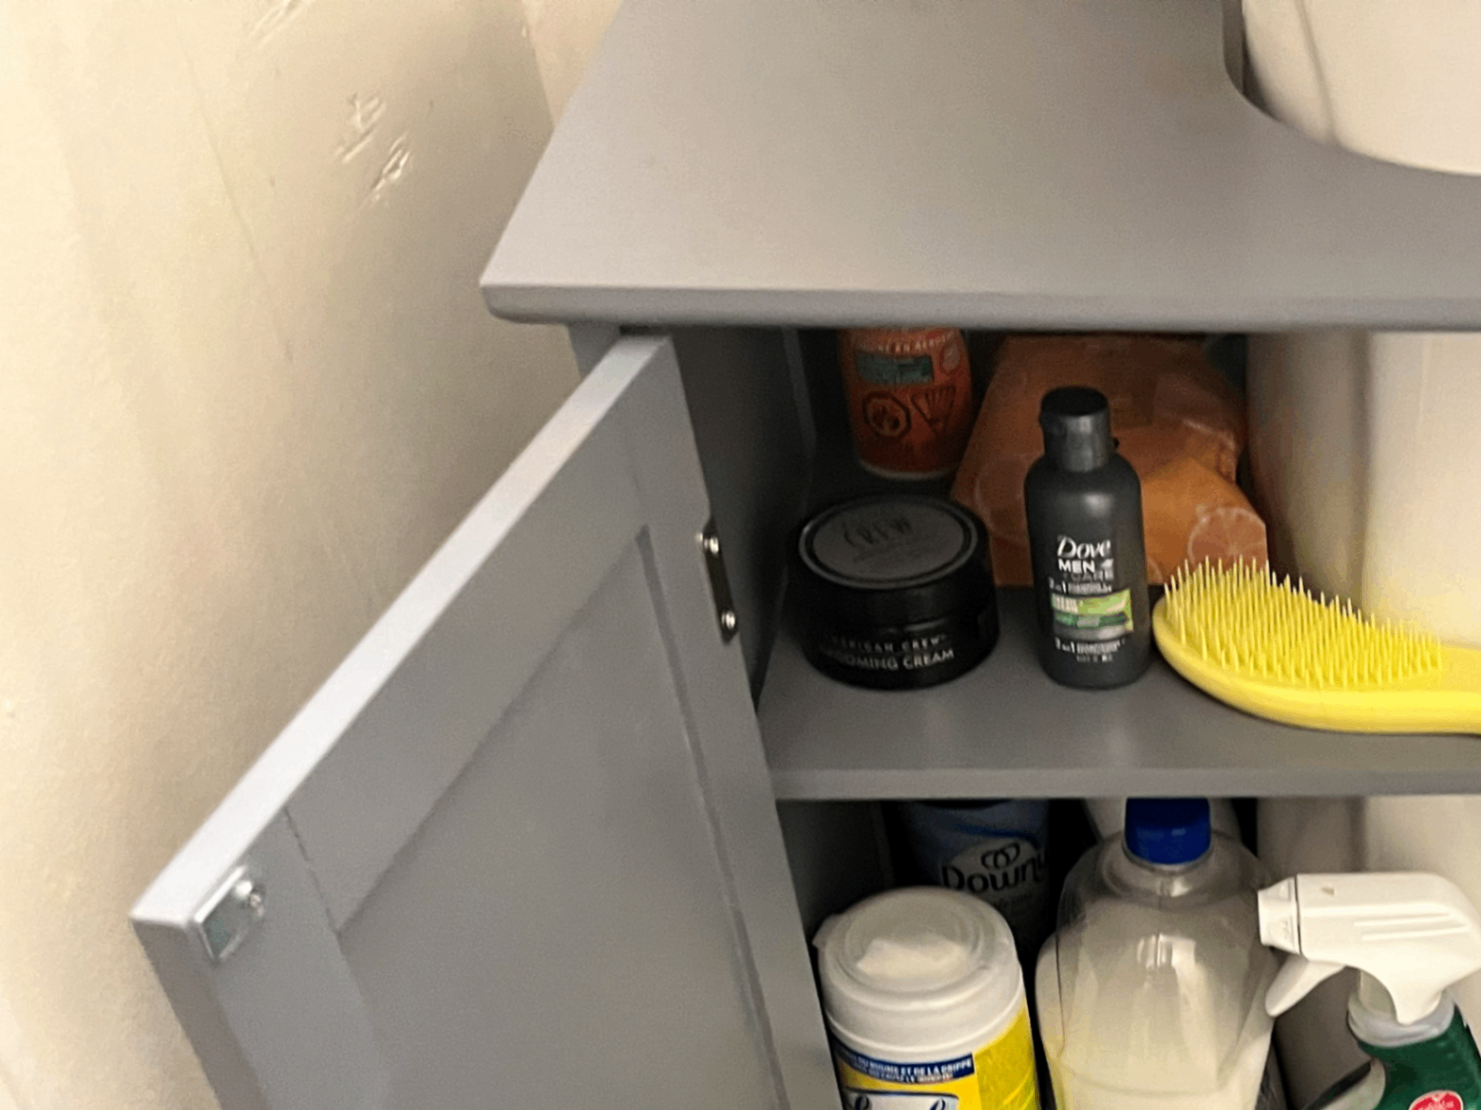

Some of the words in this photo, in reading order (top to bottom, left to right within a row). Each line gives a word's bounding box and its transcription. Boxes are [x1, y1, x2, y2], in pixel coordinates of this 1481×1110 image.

[1057, 536, 1111, 559] Dove
[1058, 559, 1096, 574] MEN
[902, 649, 955, 671] CREAM
